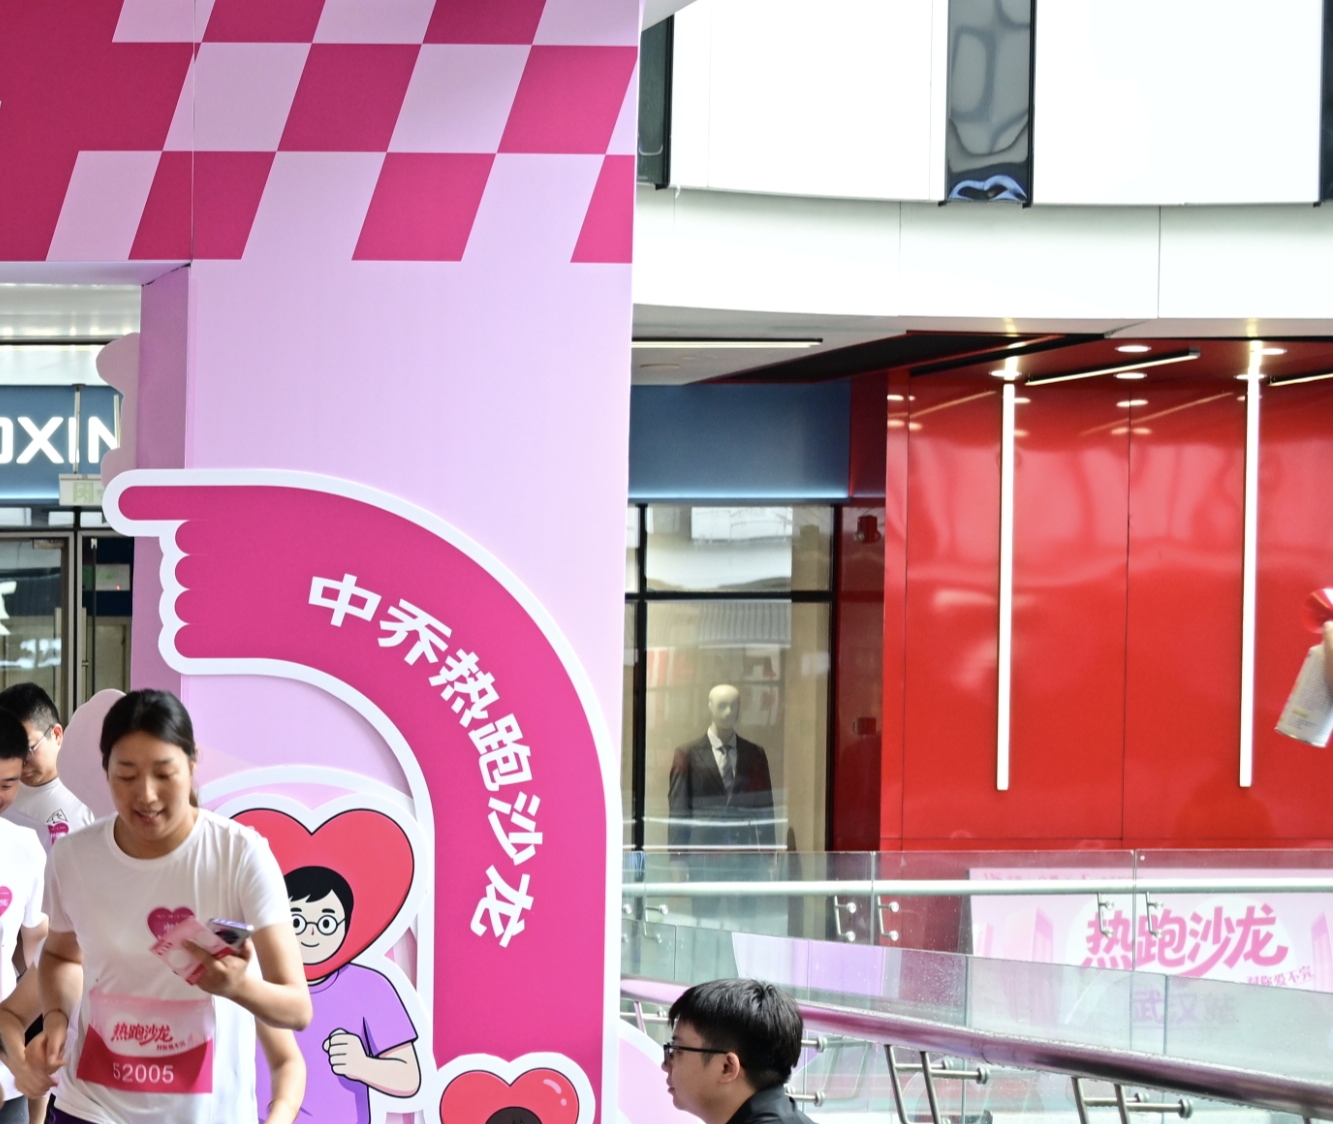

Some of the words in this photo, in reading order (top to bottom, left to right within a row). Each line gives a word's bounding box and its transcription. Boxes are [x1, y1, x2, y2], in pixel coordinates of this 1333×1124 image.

[307, 572, 544, 949] 中乔热跑沙龙
[1079, 903, 1290, 978] 热跑沙龙
[110, 1021, 174, 1047] 热跑沙龙
[112, 1062, 175, 1084] 52005
